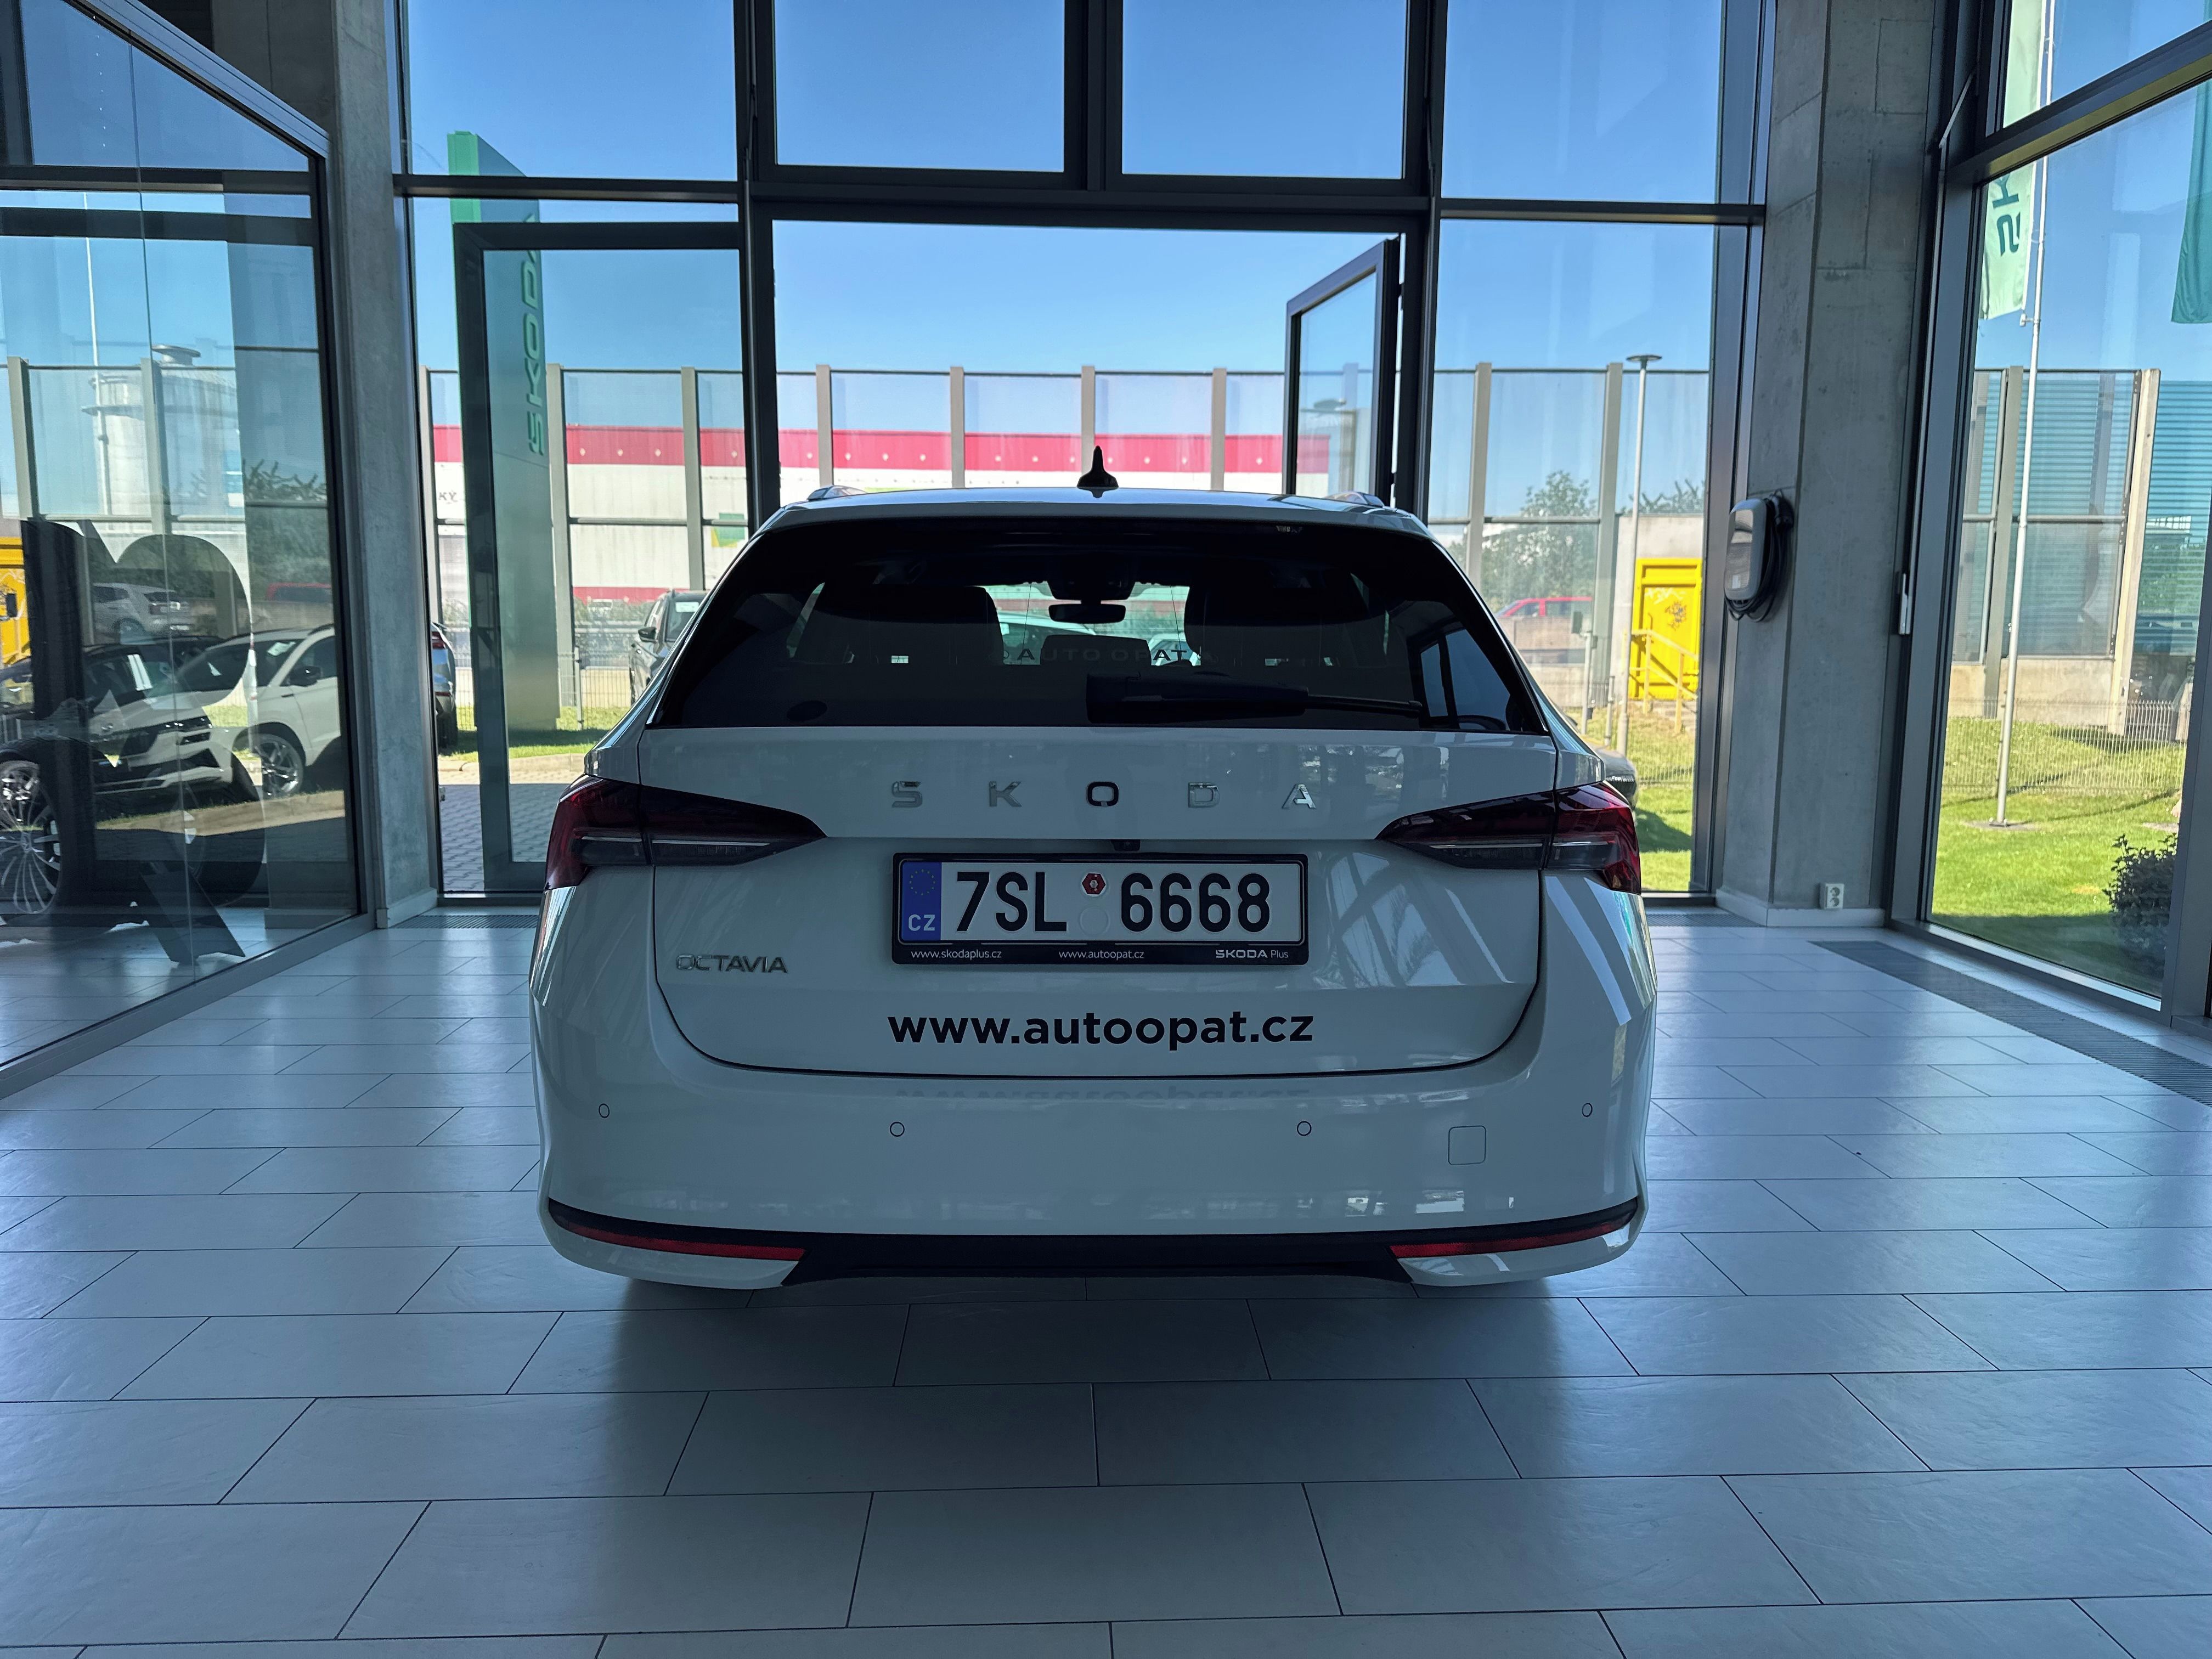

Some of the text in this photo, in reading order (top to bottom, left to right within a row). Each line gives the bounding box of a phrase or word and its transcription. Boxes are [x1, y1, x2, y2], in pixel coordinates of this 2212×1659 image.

[956, 871, 1270, 933] 7SL 6668
[908, 914, 935, 931] CZ
[911, 949, 1002, 960] www.skodaplus.cz
[1058, 949, 1144, 961] www.autoopat.cz
[1271, 950, 1289, 958] Plus
[676, 953, 788, 974] OCTAVIA
[887, 1011, 1314, 1051] www.autoopat.cz
